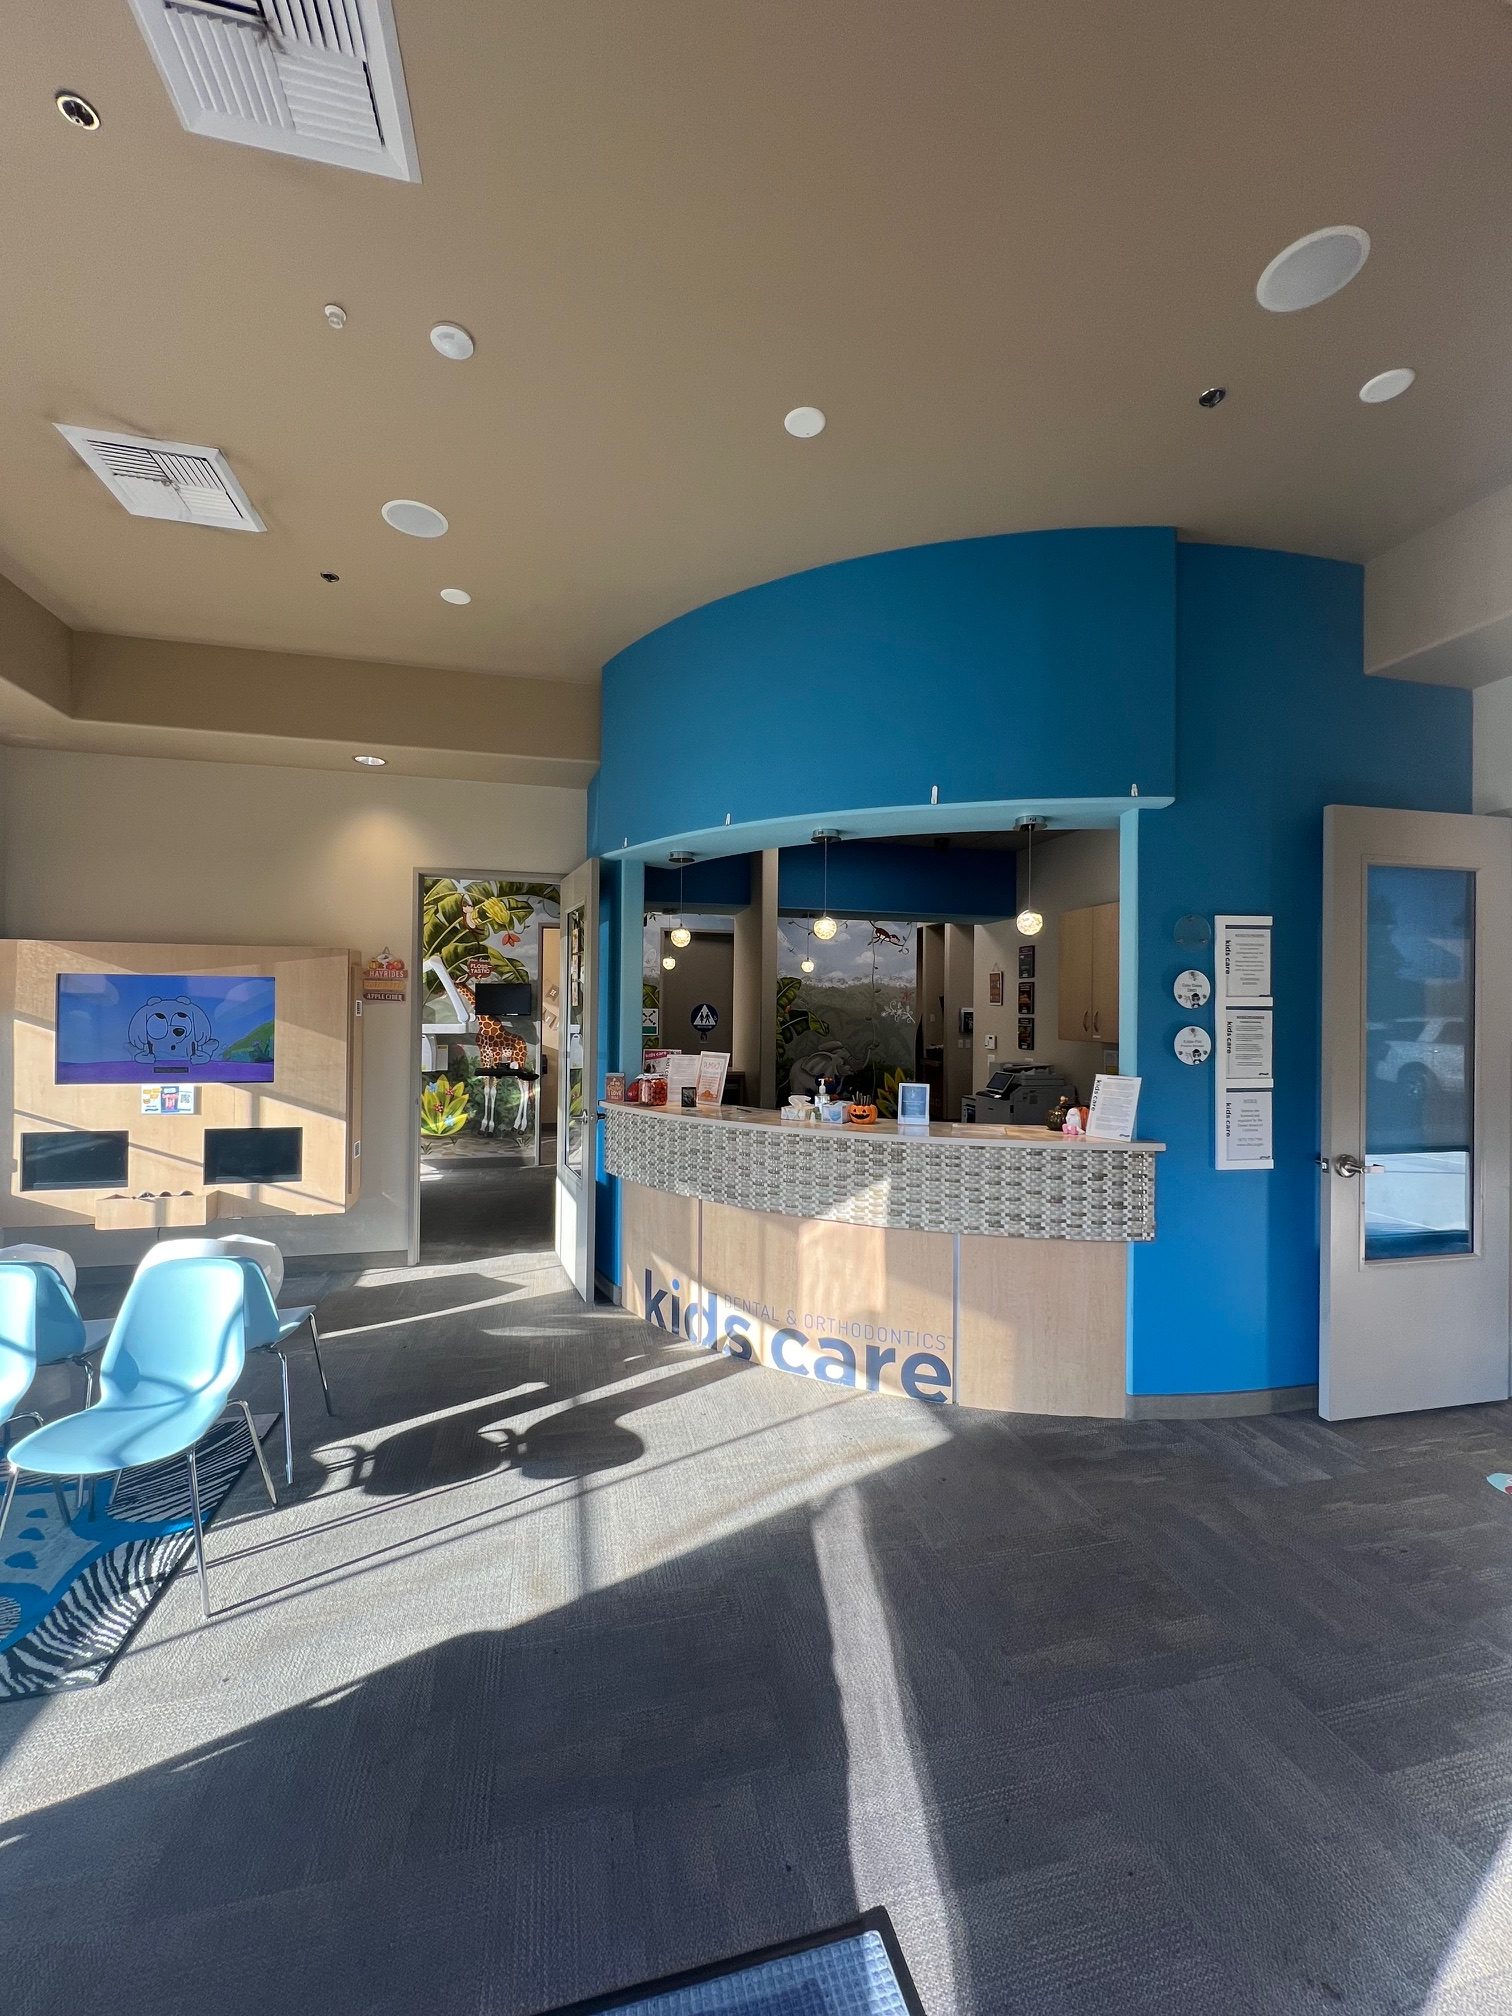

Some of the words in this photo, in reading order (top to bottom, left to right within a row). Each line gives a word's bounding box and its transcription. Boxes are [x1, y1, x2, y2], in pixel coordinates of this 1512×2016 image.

[369, 970, 404, 978] HAYRIDES
[645, 1268, 752, 1361] kids
[771, 1327, 952, 1403] care
[724, 1294, 779, 1322] DENTAL
[786, 1309, 797, 1327] &
[804, 1313, 946, 1351] ORTHODONTICS
